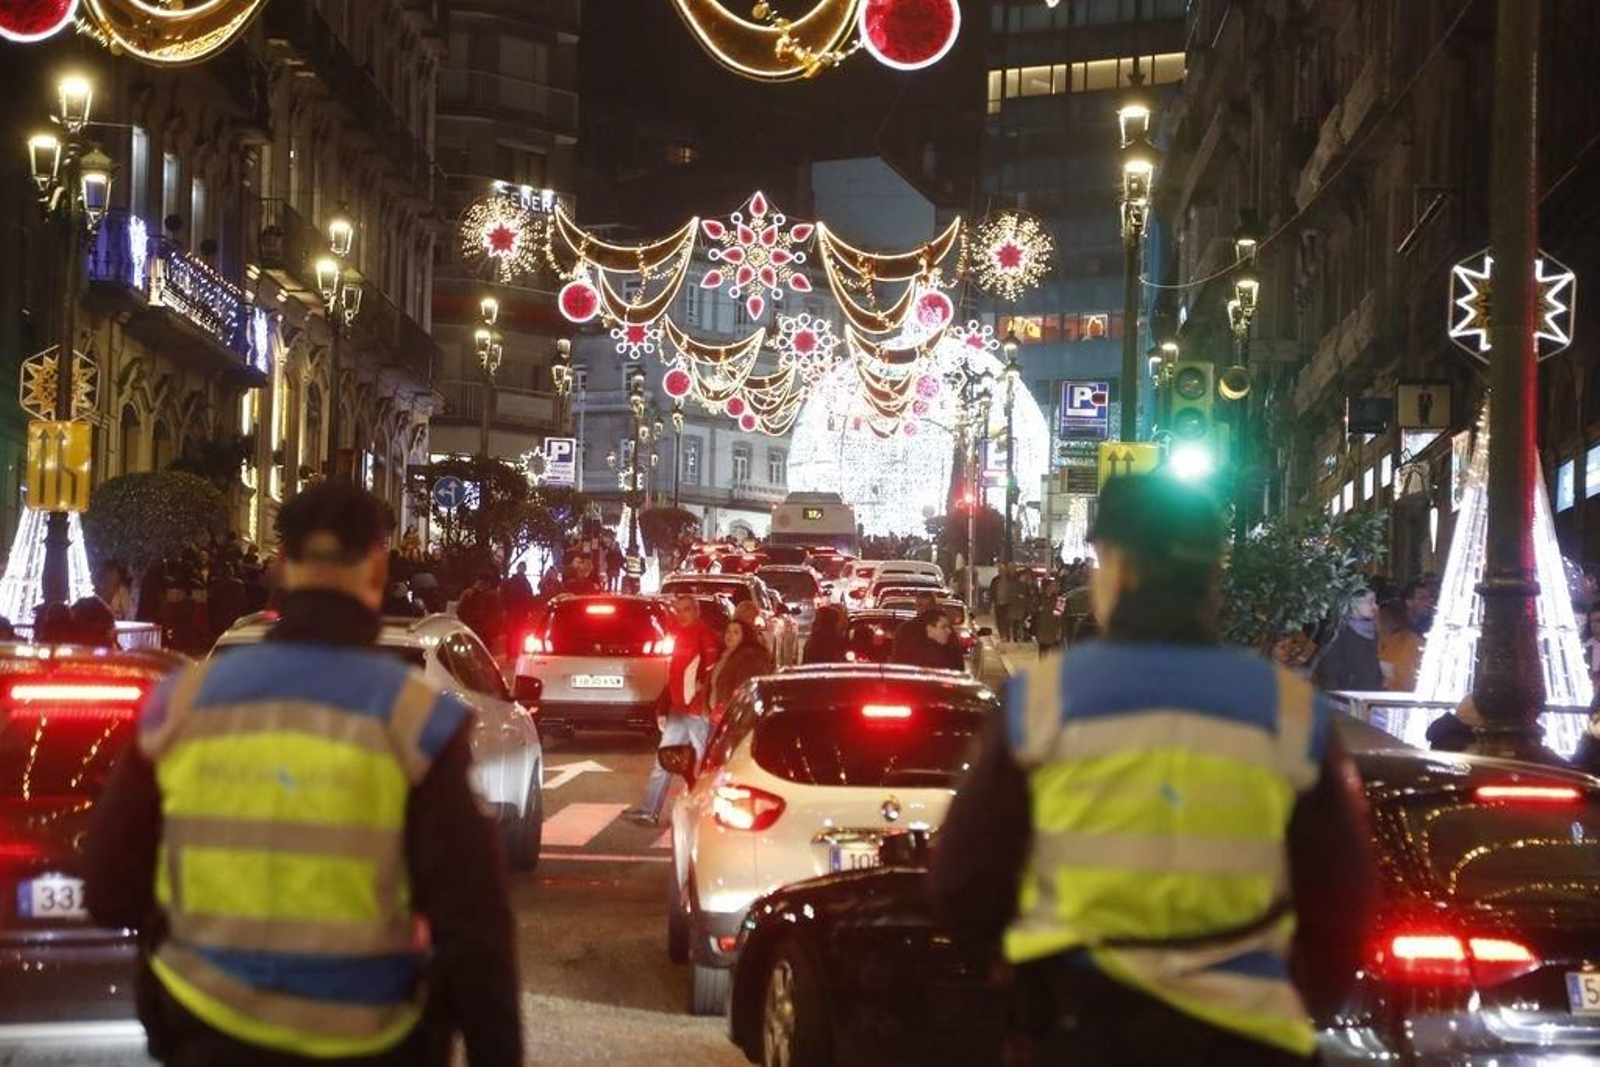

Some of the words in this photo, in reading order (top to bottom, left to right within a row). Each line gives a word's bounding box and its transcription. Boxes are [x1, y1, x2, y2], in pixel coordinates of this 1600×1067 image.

[1074, 387, 1092, 408] P
[551, 441, 570, 461] P
[1585, 979, 1598, 1004] 5
